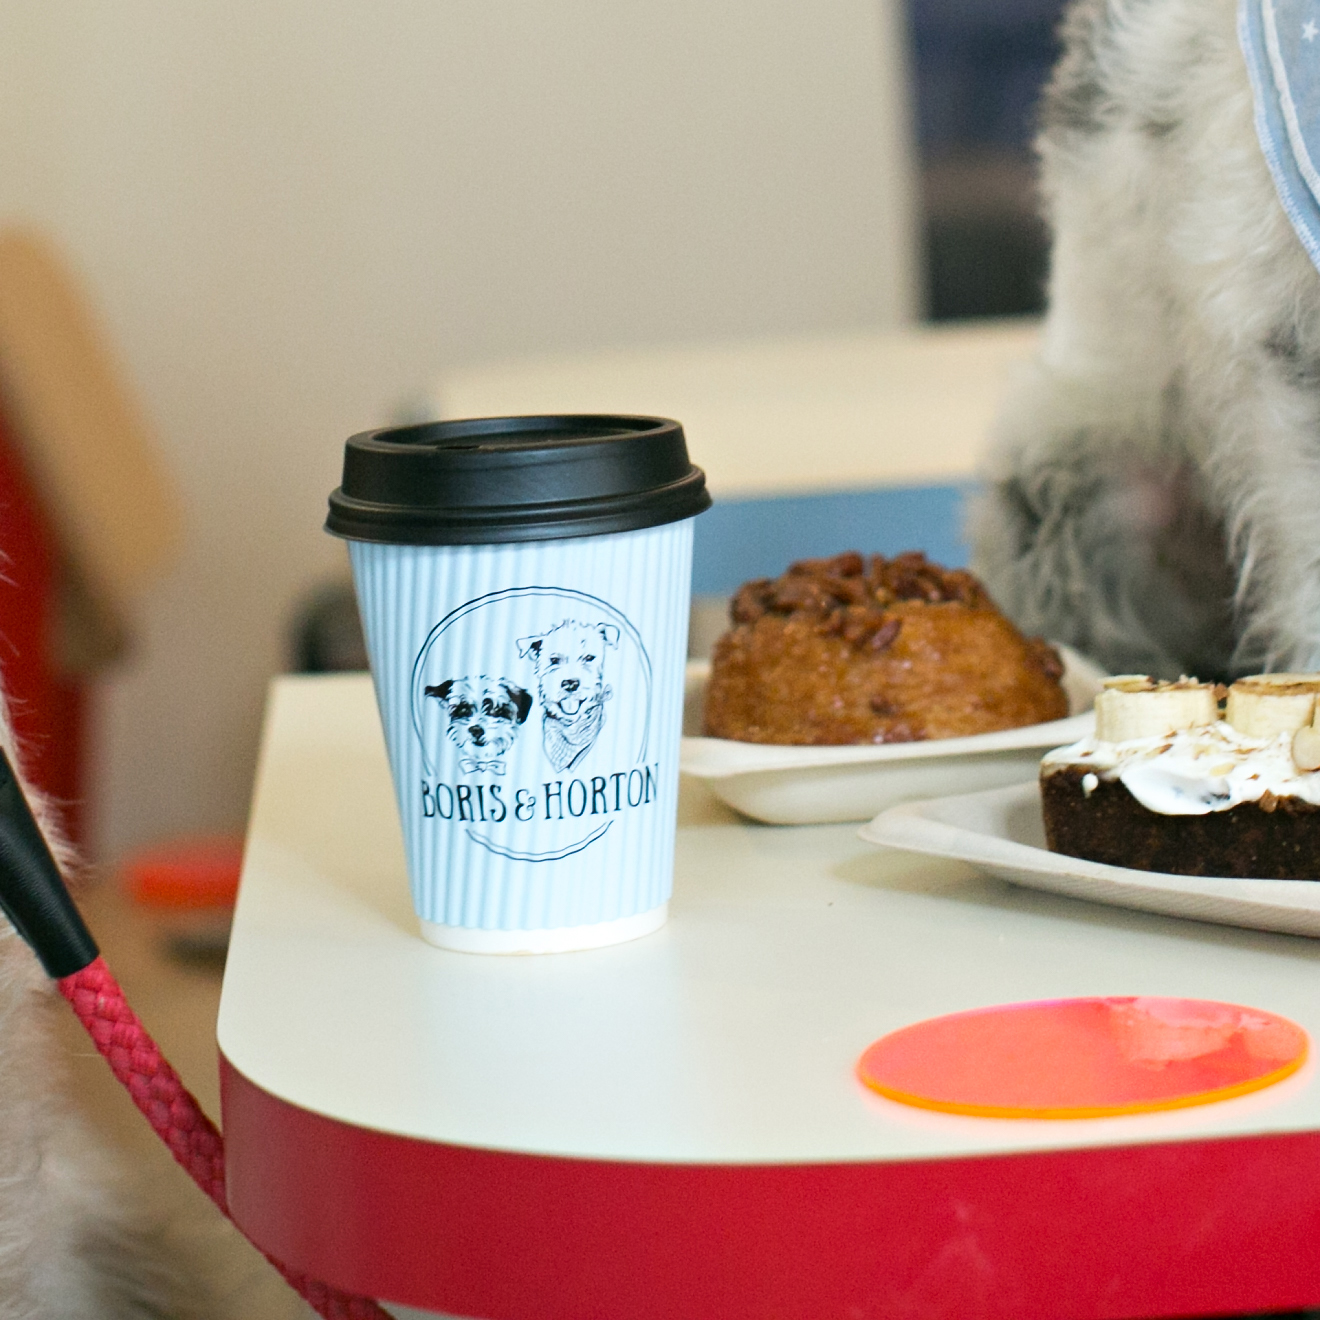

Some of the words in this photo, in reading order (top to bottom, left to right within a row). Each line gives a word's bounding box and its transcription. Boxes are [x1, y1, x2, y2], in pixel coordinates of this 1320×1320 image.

[421, 779, 507, 823] BORIS
[514, 788, 537, 822] &
[543, 762, 659, 822] HORTON
